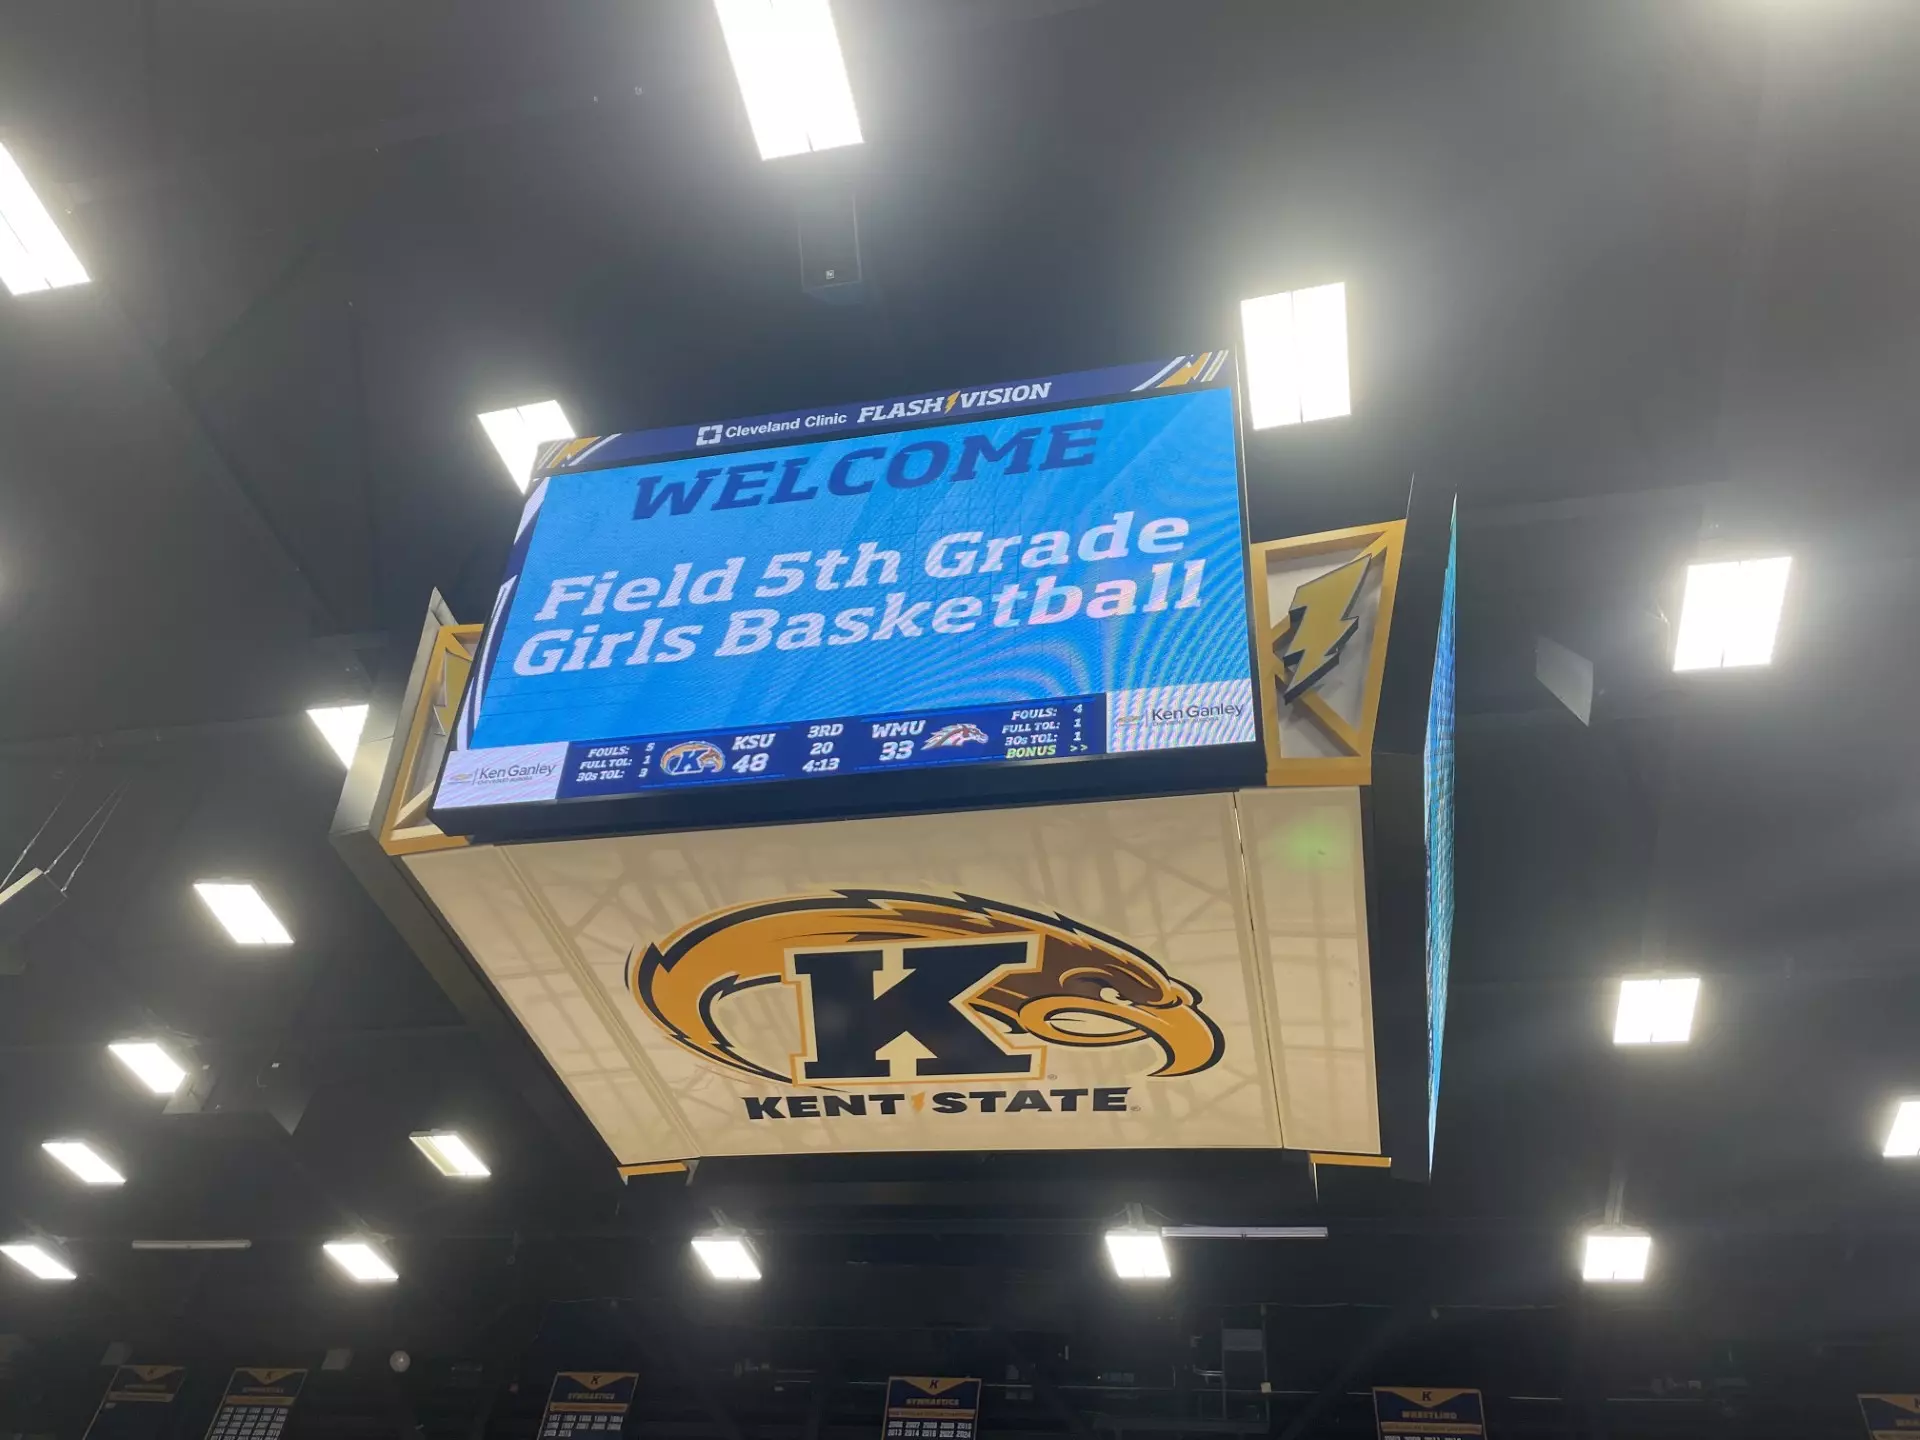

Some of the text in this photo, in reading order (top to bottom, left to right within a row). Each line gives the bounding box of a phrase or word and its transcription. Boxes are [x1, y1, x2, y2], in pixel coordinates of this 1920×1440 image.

[857, 381, 1053, 424] FLASH VISION
[725, 412, 848, 438] Cleveland Clinic
[631, 418, 1105, 521] WELCOME
[533, 510, 1190, 622] Field 5th Grade
[513, 558, 1207, 676] Girls Basketball
[1011, 703, 1083, 721] FOULS: 4
[1152, 707, 1183, 722] Ken
[1186, 702, 1244, 718] Ganley
[807, 723, 844, 739] 3RD
[872, 719, 926, 739] WMU
[1002, 723, 1032, 734] FULL
[1073, 718, 1082, 728] 1
[731, 733, 776, 751] KSU
[1073, 731, 1082, 741] 1
[588, 745, 630, 758] FOULS:
[810, 741, 834, 756] 20
[879, 739, 914, 761] 33
[1005, 744, 1057, 759] BONUS
[479, 763, 557, 780] Ken Ganley
[579, 760, 607, 770] FULL
[642, 755, 651, 764] 1
[731, 753, 769, 774] 48
[802, 757, 840, 773] 4:13
[788, 937, 1042, 1084] K
[741, 1087, 1133, 1120] KENT STATE
